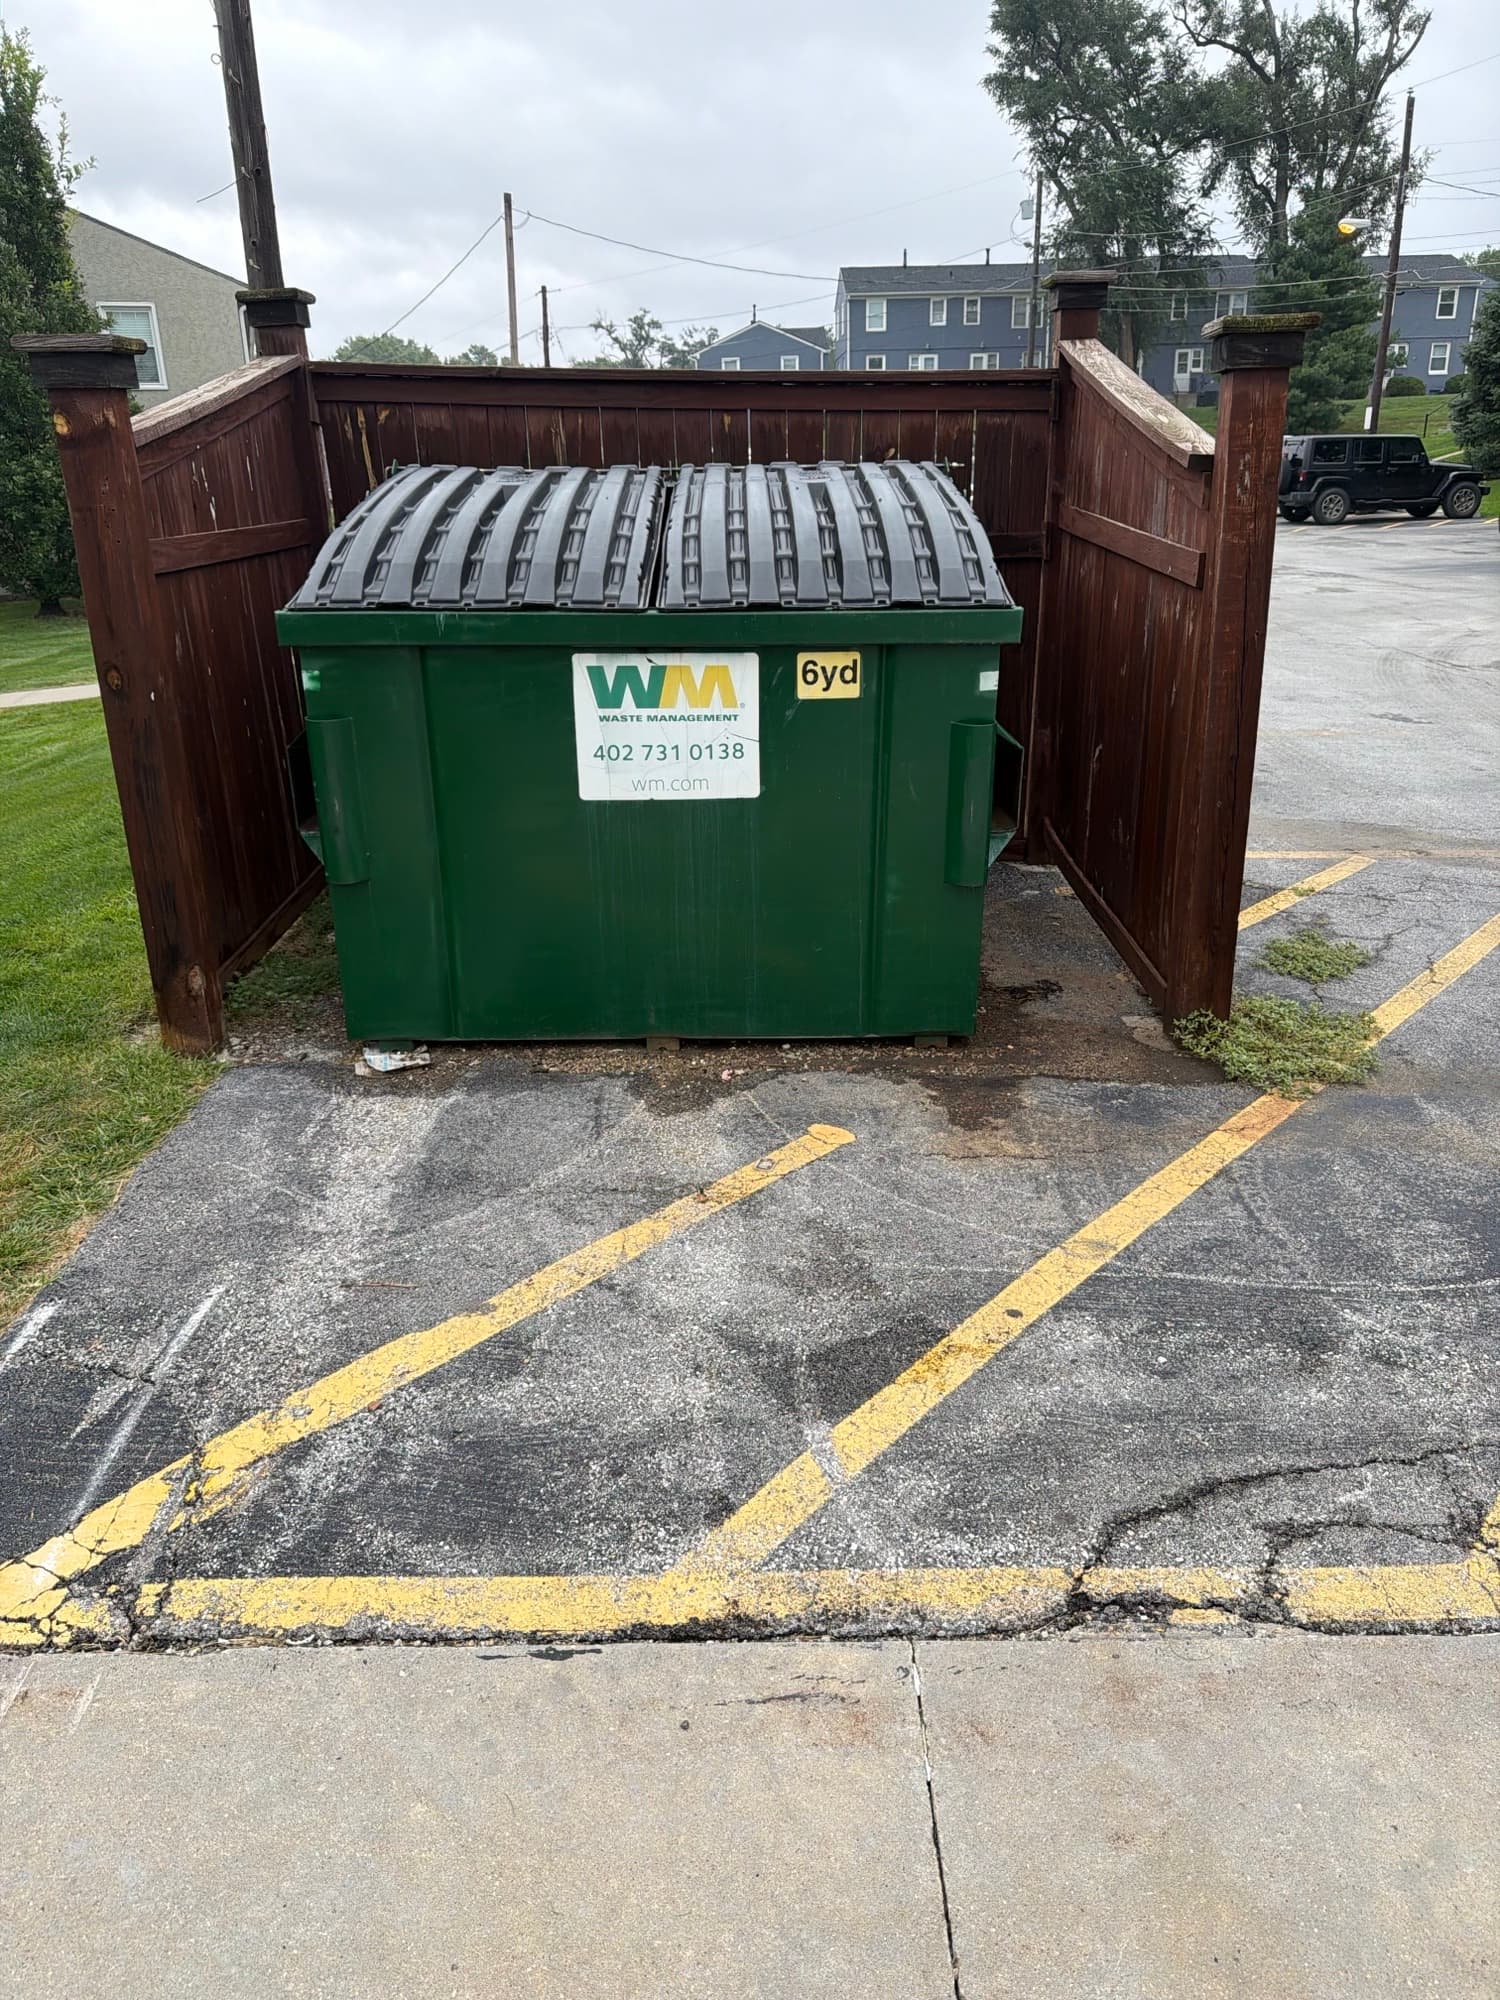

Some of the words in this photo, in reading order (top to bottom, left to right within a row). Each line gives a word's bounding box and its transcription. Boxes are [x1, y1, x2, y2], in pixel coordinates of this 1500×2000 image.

[801, 658, 858, 692] 6yd
[586, 665, 739, 709] WM
[598, 714, 643, 723] WASTE
[646, 713, 740, 723] MANAGEMENT
[593, 744, 634, 761] 402
[641, 744, 680, 761] 731
[689, 742, 744, 760] 0138
[631, 777, 709, 792] wm.com
